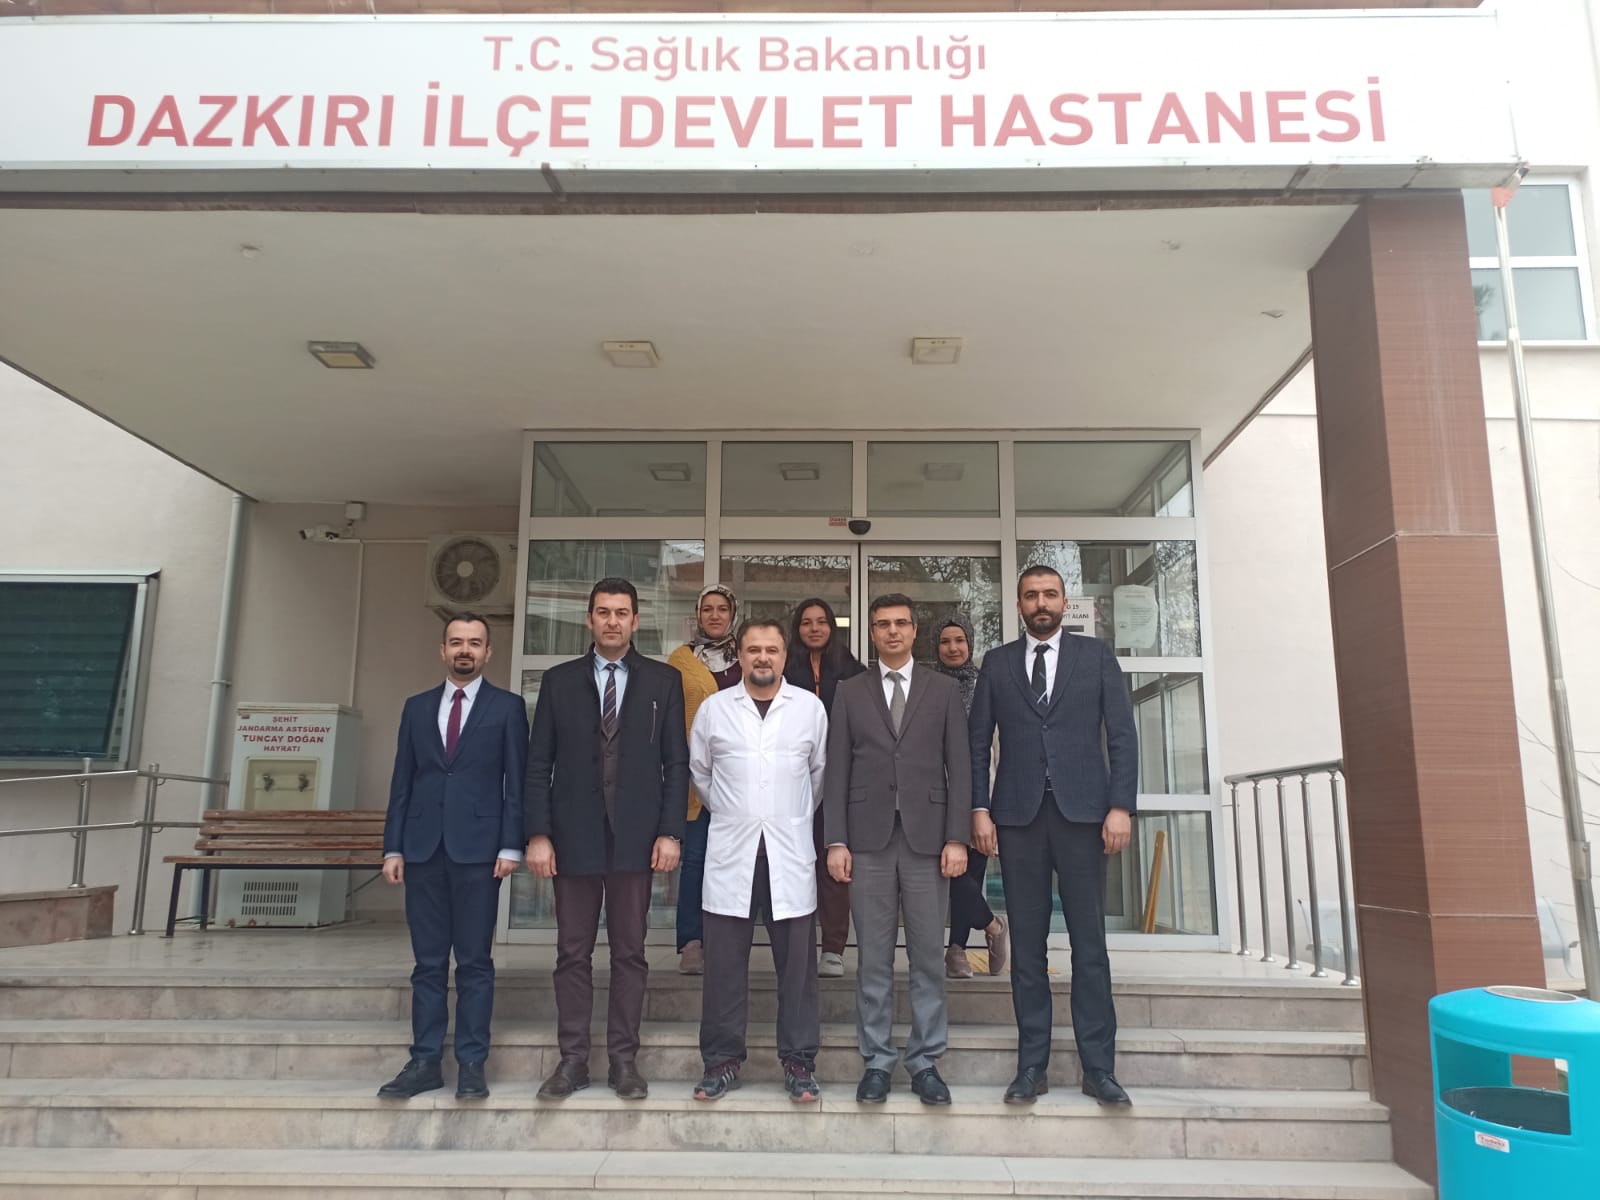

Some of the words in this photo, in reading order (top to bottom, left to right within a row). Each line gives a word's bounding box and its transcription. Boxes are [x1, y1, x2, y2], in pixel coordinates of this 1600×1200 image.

[484, 37, 573, 71] T.C.
[591, 36, 740, 81] Sağlık
[760, 35, 987, 80] Bakanlığı
[88, 94, 393, 147] DAZKIRI
[423, 81, 592, 157] İLÇE
[620, 94, 913, 149] DEVLET
[941, 76, 1387, 148] HASTANESİ
[287, 734, 324, 743] DOĞAN
